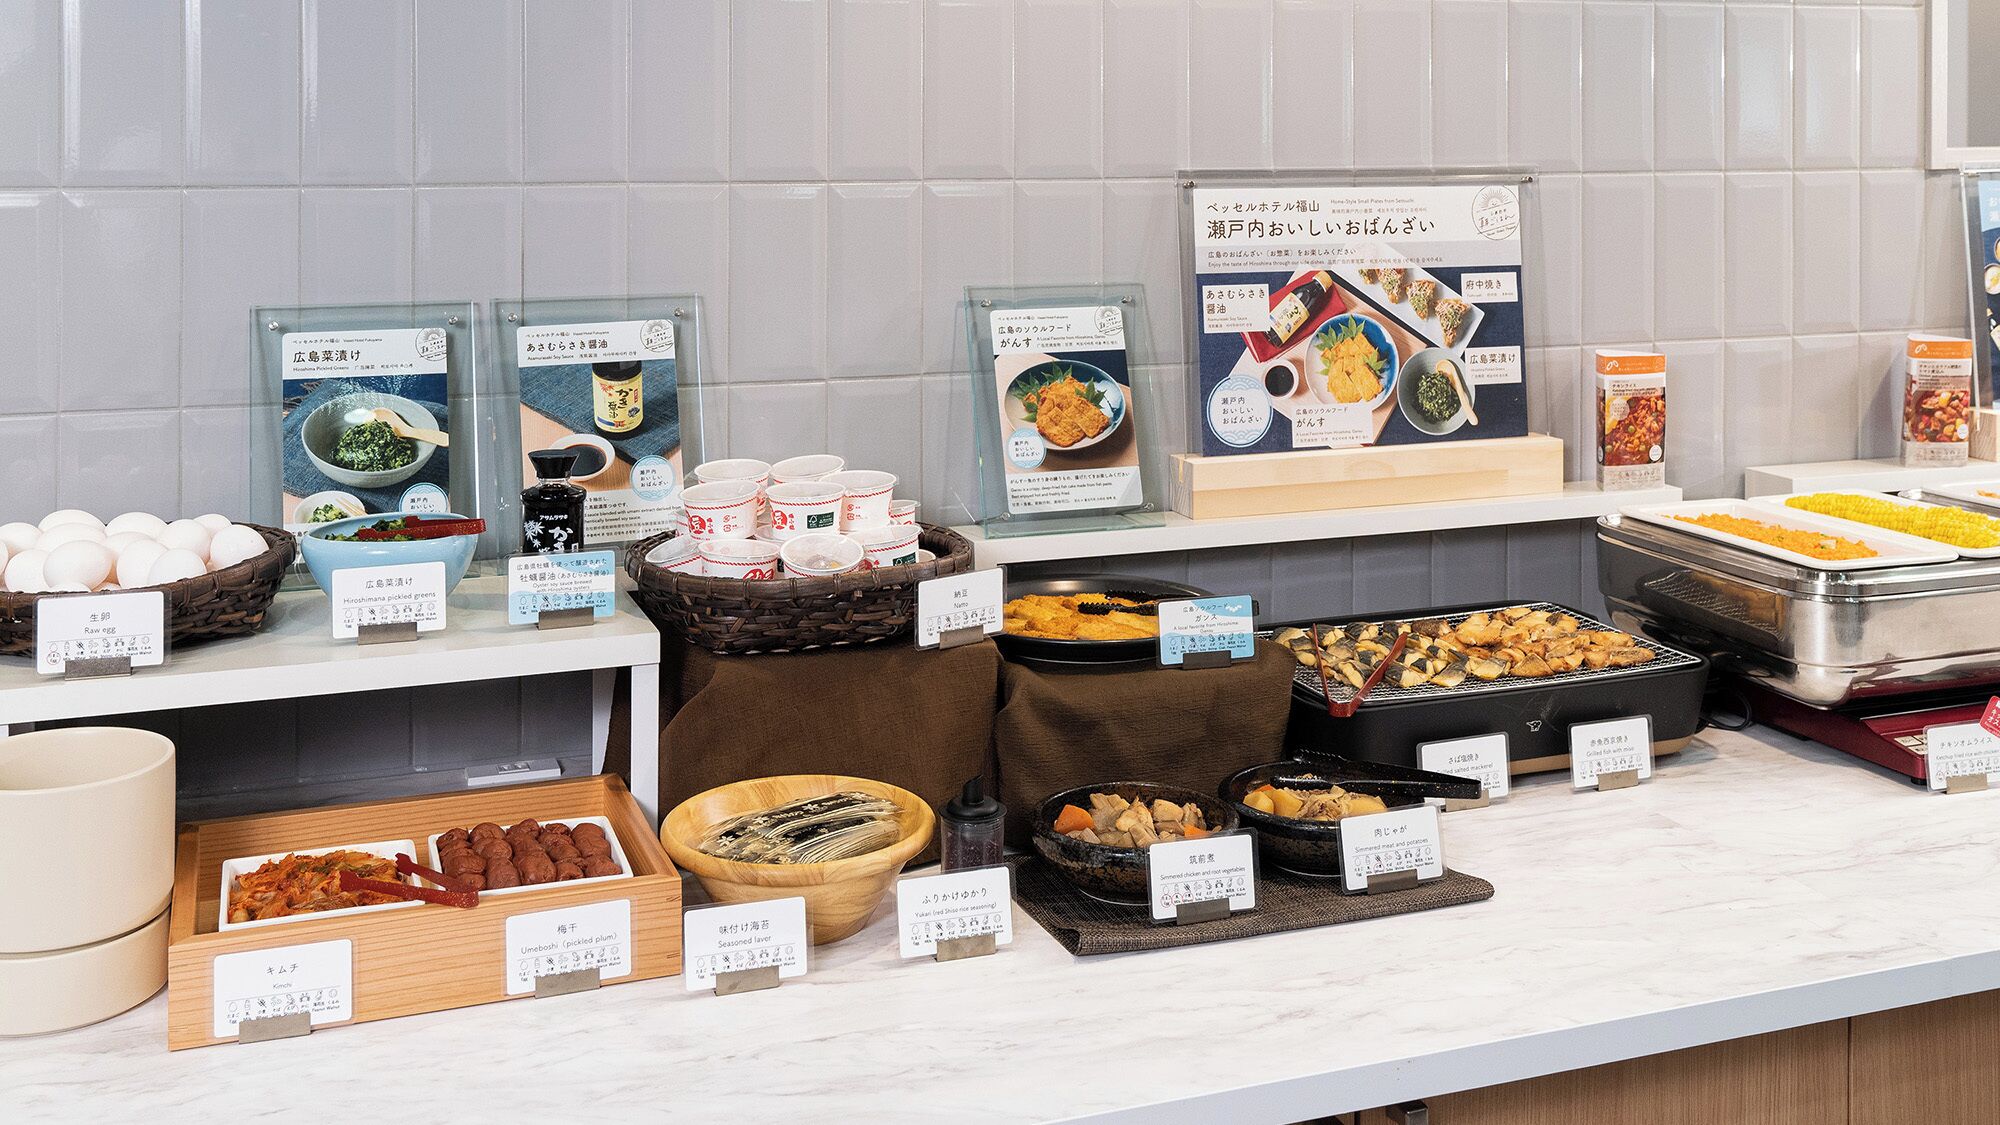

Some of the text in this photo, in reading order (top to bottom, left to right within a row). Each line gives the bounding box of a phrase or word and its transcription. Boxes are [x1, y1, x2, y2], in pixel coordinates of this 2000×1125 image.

[1207, 200, 1319, 213] ベッセルホテル福山
[1207, 216, 1435, 239] 瀬戸内おいしいおばんざい
[1466, 280, 1501, 289] 府中焼き
[1207, 288, 1265, 299] あさむらさき
[1207, 304, 1226, 314] 醤油
[998, 324, 1071, 334] 広島のソウルフード
[527, 339, 608, 352] あさむらさき醤油
[1001, 337, 1031, 348] がんす
[293, 350, 360, 363] 広島菜漬け
[1470, 353, 1515, 364] 広島菜漬け
[1221, 397, 1245, 405] 瀬戸内
[1223, 406, 1253, 414] おいしい
[1296, 407, 1348, 415] 広島のソウルフード
[1223, 416, 1263, 424] おばんざい
[1297, 417, 1325, 428] がんす
[366, 577, 413, 588] 広島菜漬け
[344, 596, 385, 604] Hiroshimana
[414, 592, 435, 600] greens
[954, 589, 968, 598] 納豆
[1183, 603, 1228, 612] 広島ソウルフード
[90, 612, 110, 622] 生卵
[1196, 614, 1217, 622] ガンス
[1940, 737, 1992, 749] チキンオムライス
[1471, 763, 1493, 771] mackerel
[1374, 825, 1407, 837] 肉じゃが
[1355, 845, 1380, 853] Simmered
[1189, 853, 1215, 864] 筑前煮
[922, 888, 987, 904] ふりかけゆかり
[971, 902, 997, 911] seasoning)
[558, 923, 577, 934] 梅干
[719, 920, 769, 934] 味付け海苔
[521, 943, 558, 954] Umeboshi
[718, 938, 752, 948] Seasoned
[267, 964, 298, 975] キムチ
